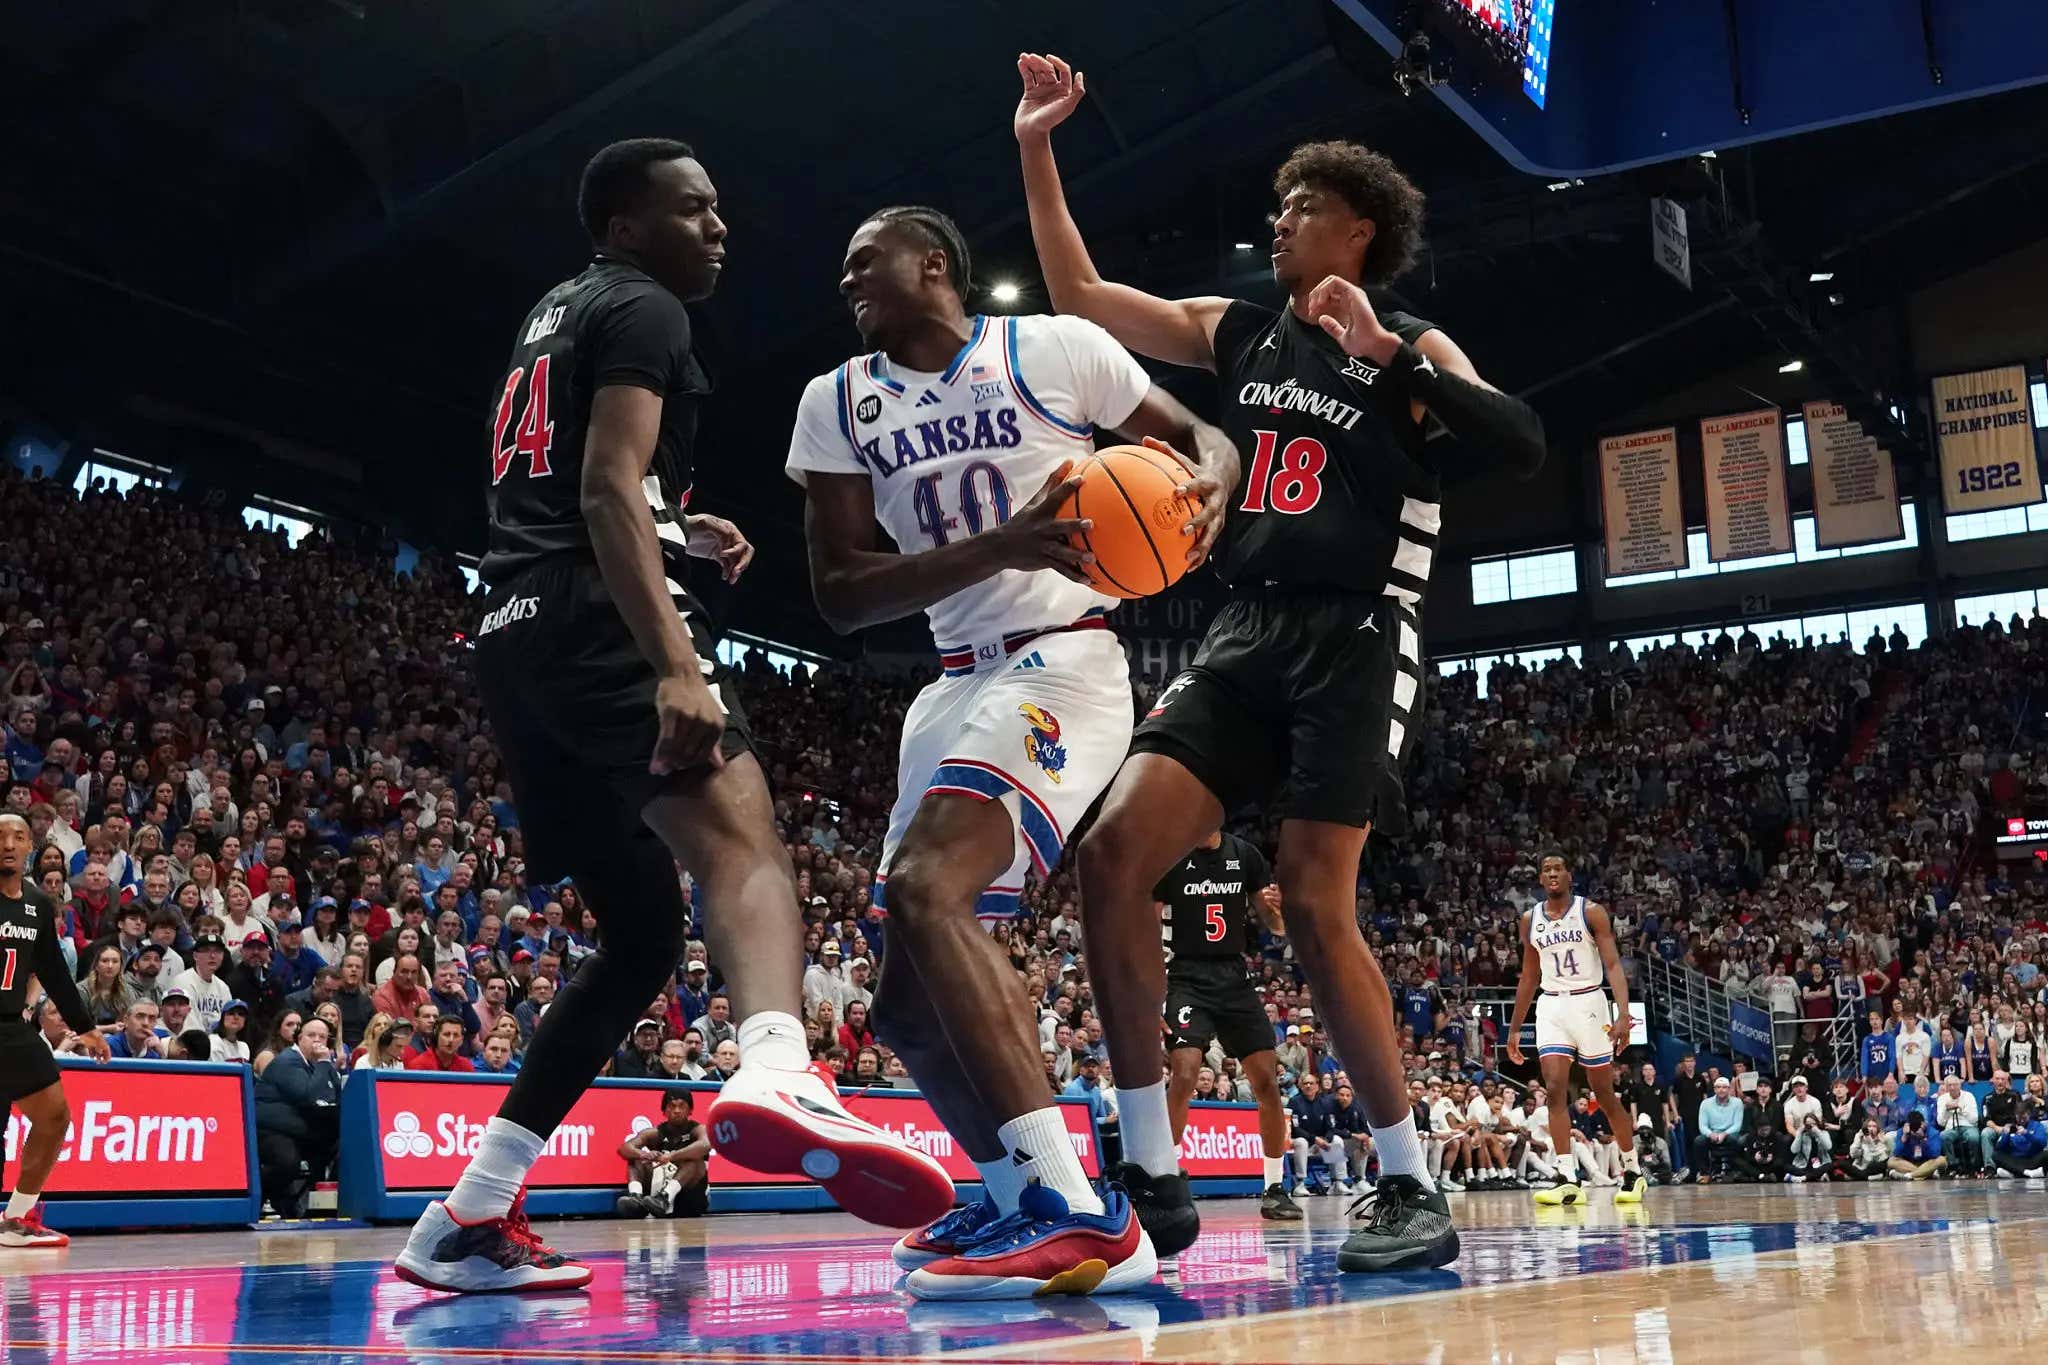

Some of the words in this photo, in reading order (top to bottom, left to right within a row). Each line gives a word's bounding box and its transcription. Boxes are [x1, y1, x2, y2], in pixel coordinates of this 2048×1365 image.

[859, 398, 878, 419] SW
[1239, 378, 1363, 430] CINCINNATI
[1945, 389, 2018, 412] NATIONAL
[492, 354, 554, 486] 24
[1939, 410, 2027, 435] CHAMPIONS
[863, 408, 1022, 478] KANSAS
[1239, 429, 1327, 515] 18
[1958, 461, 2022, 494] 1922
[913, 461, 1012, 549] 40
[1168, 599, 1203, 630] OF
[1744, 595, 1766, 611] 21
[979, 644, 997, 660] KU
[1042, 742, 1056, 760] KU
[1184, 879, 1242, 895] CINCINNATI
[1205, 903, 1227, 942] 5
[1536, 930, 1583, 950] KANSAS
[1, 948, 17, 990] 1
[1552, 949, 1580, 977] 14
[1871, 1050, 1886, 1064] 30
[2016, 1054, 2027, 1065] 13
[436, 1113, 489, 1157] Sta
